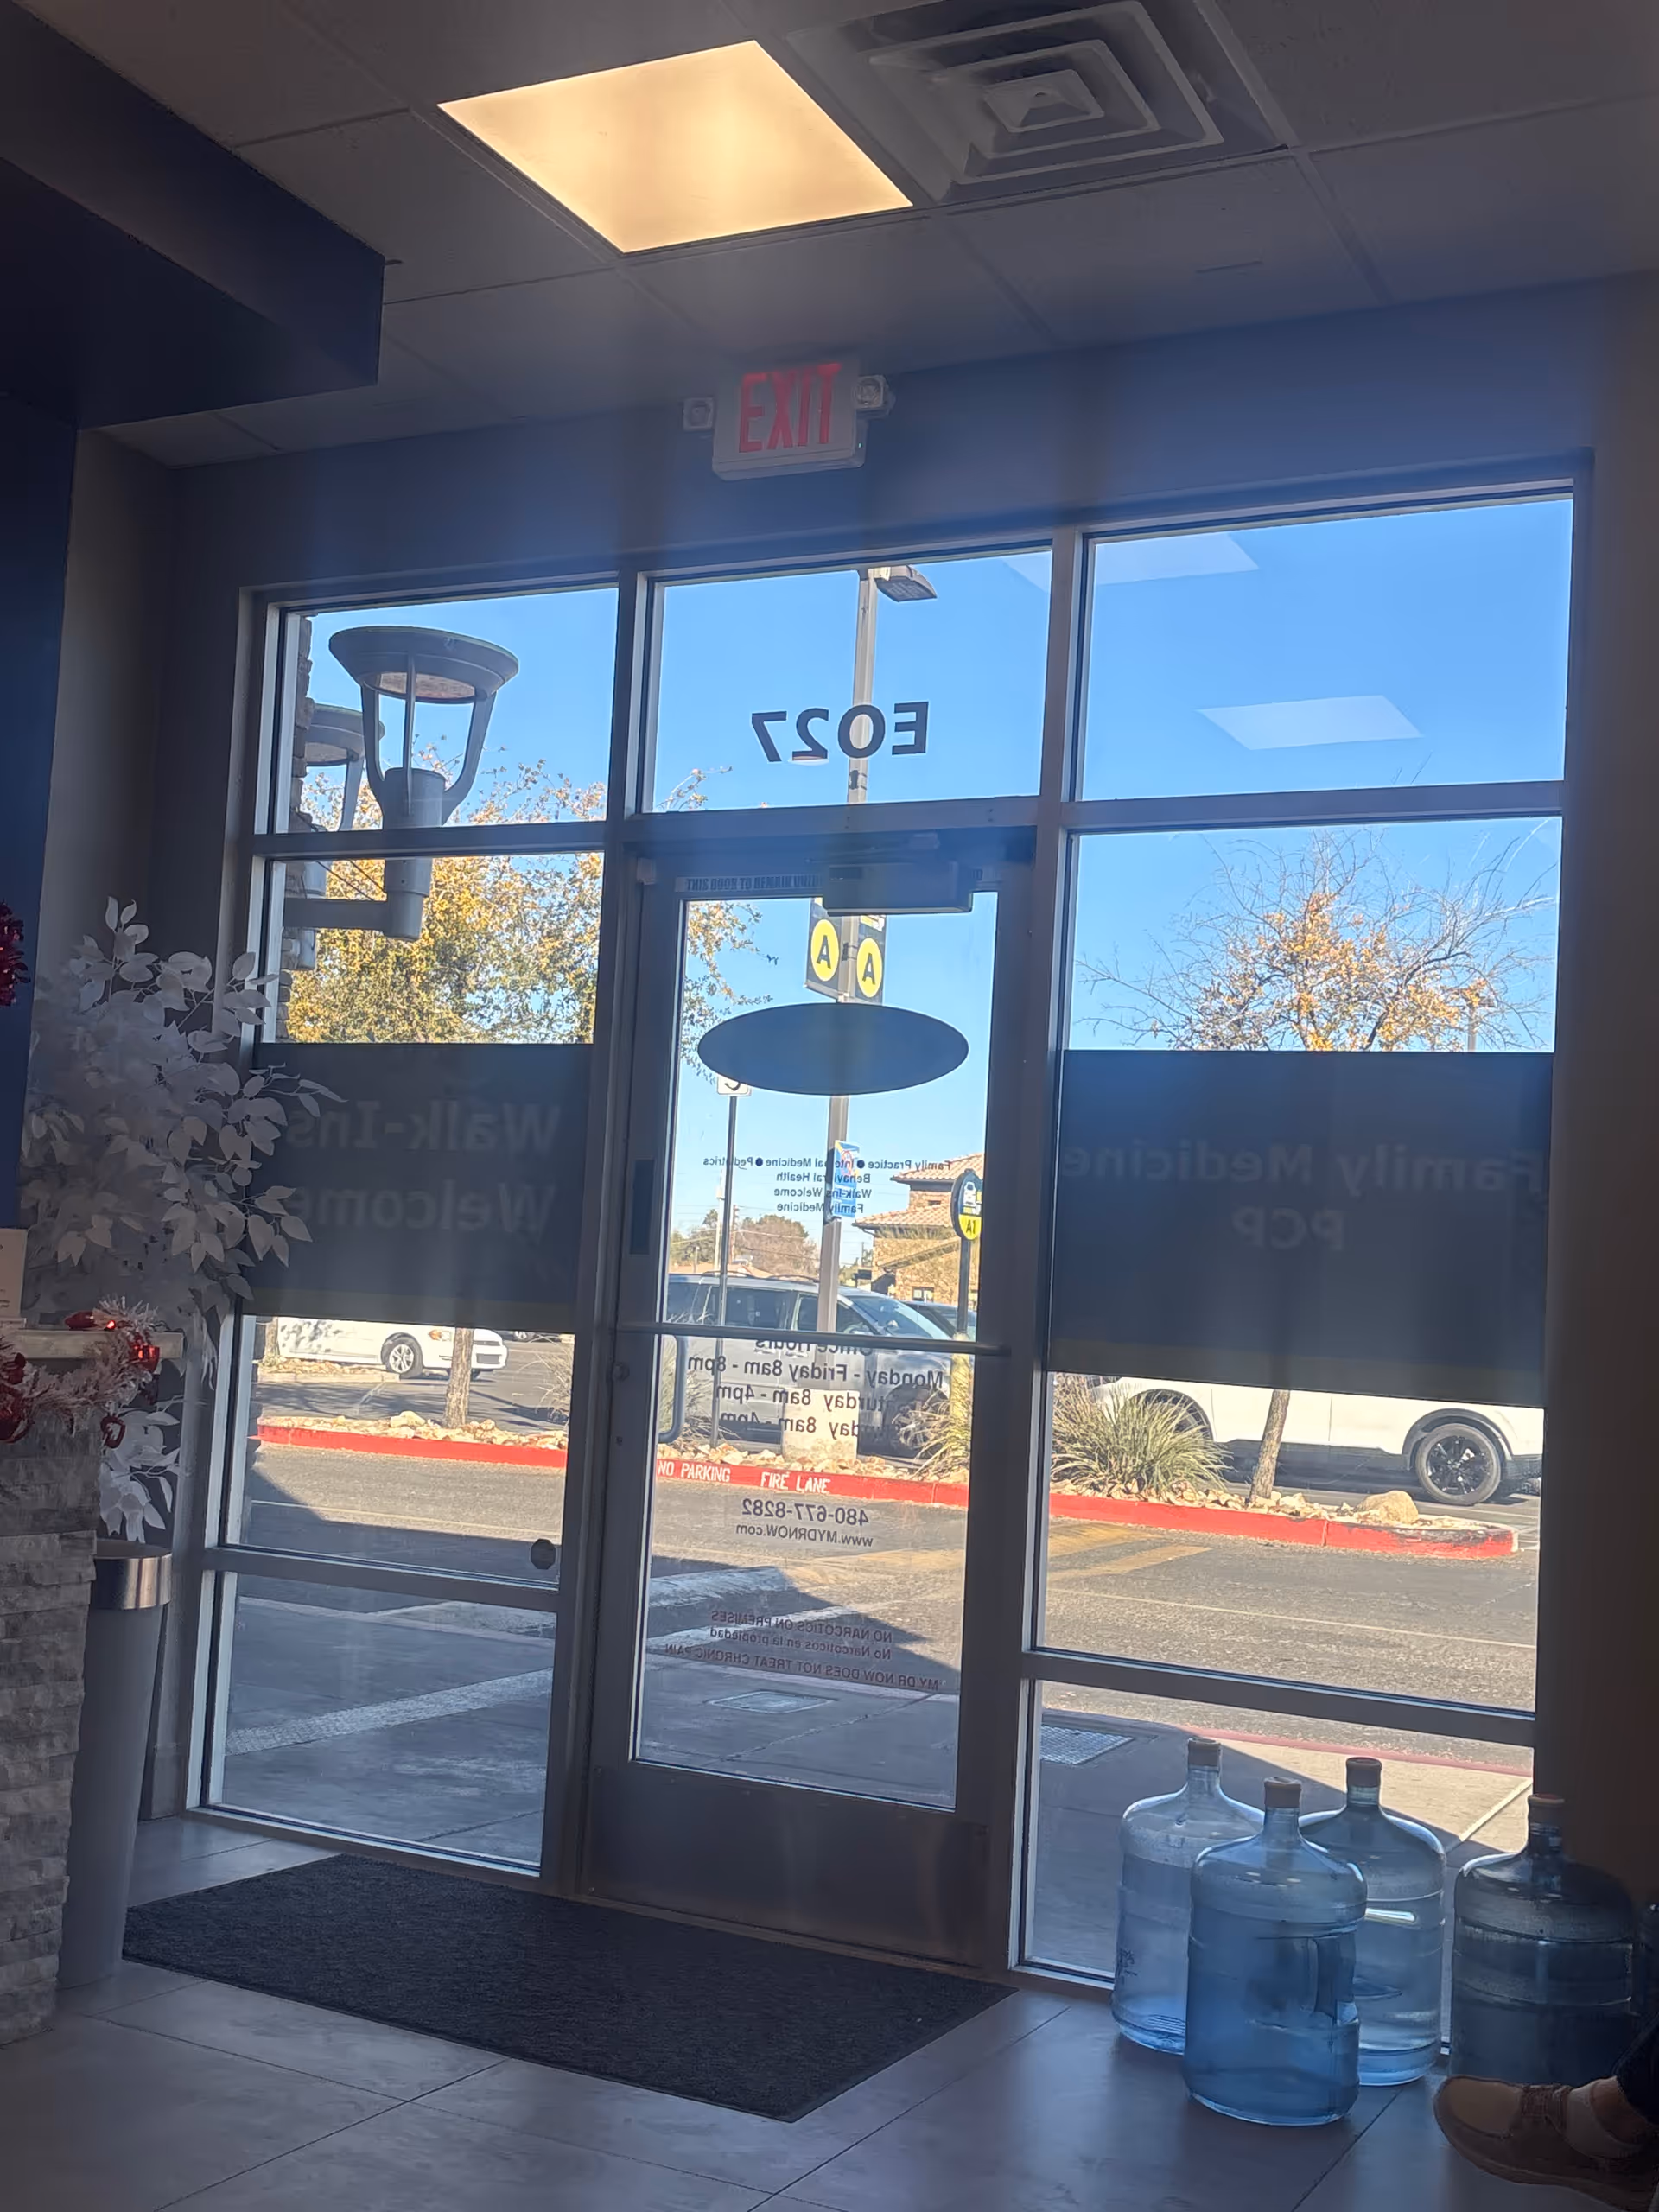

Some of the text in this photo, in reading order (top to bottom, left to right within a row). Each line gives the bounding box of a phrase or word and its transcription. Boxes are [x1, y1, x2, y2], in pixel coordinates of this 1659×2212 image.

[739, 362, 842, 453] EXIT
[687, 878, 709, 891] THIS
[816, 934, 832, 969] A
[862, 952, 876, 985] A
[658, 1459, 831, 1494] NO PARKING FIRE LANE
